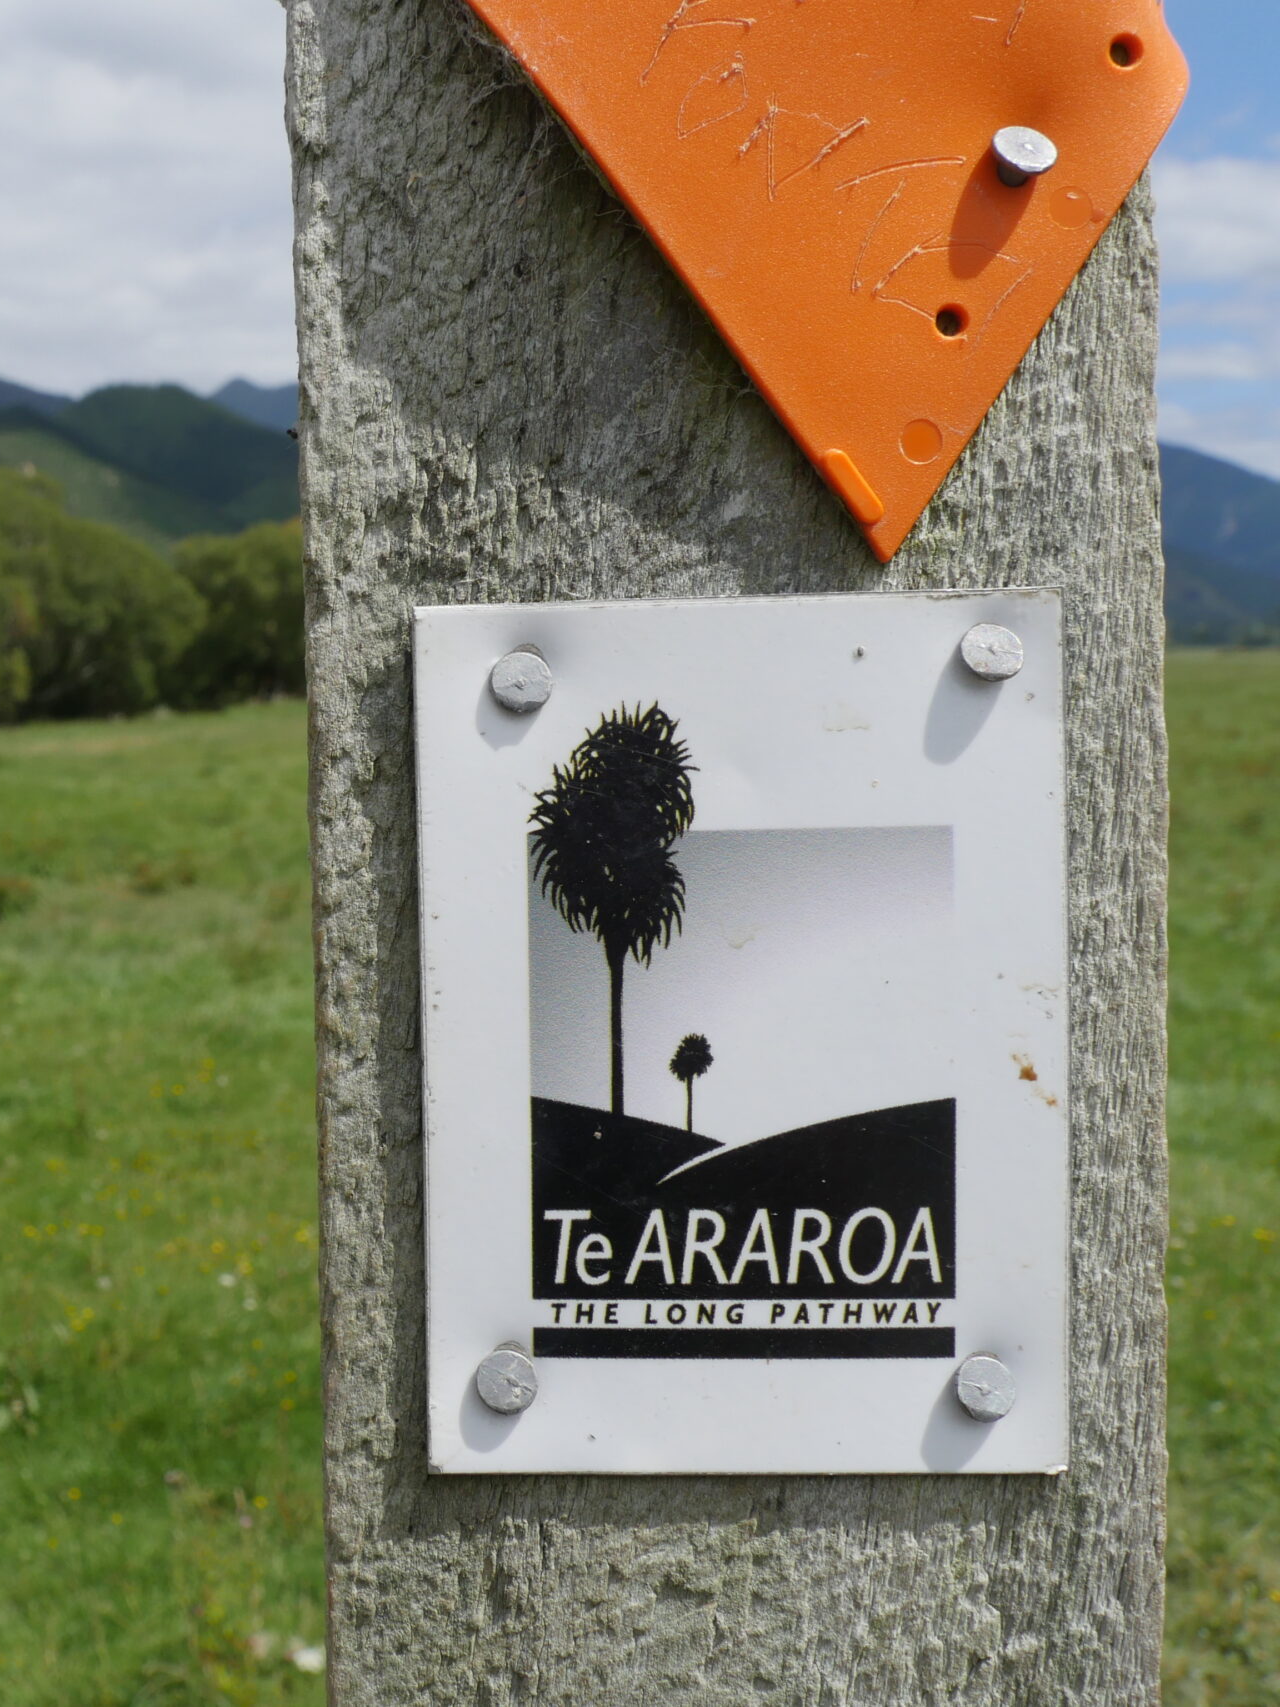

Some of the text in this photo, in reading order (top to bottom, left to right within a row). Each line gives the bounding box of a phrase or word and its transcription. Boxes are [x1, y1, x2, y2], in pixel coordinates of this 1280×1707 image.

[543, 1206, 942, 1286] Te ARAROA
[551, 1302, 942, 1325] THE LONG PATHWAY
